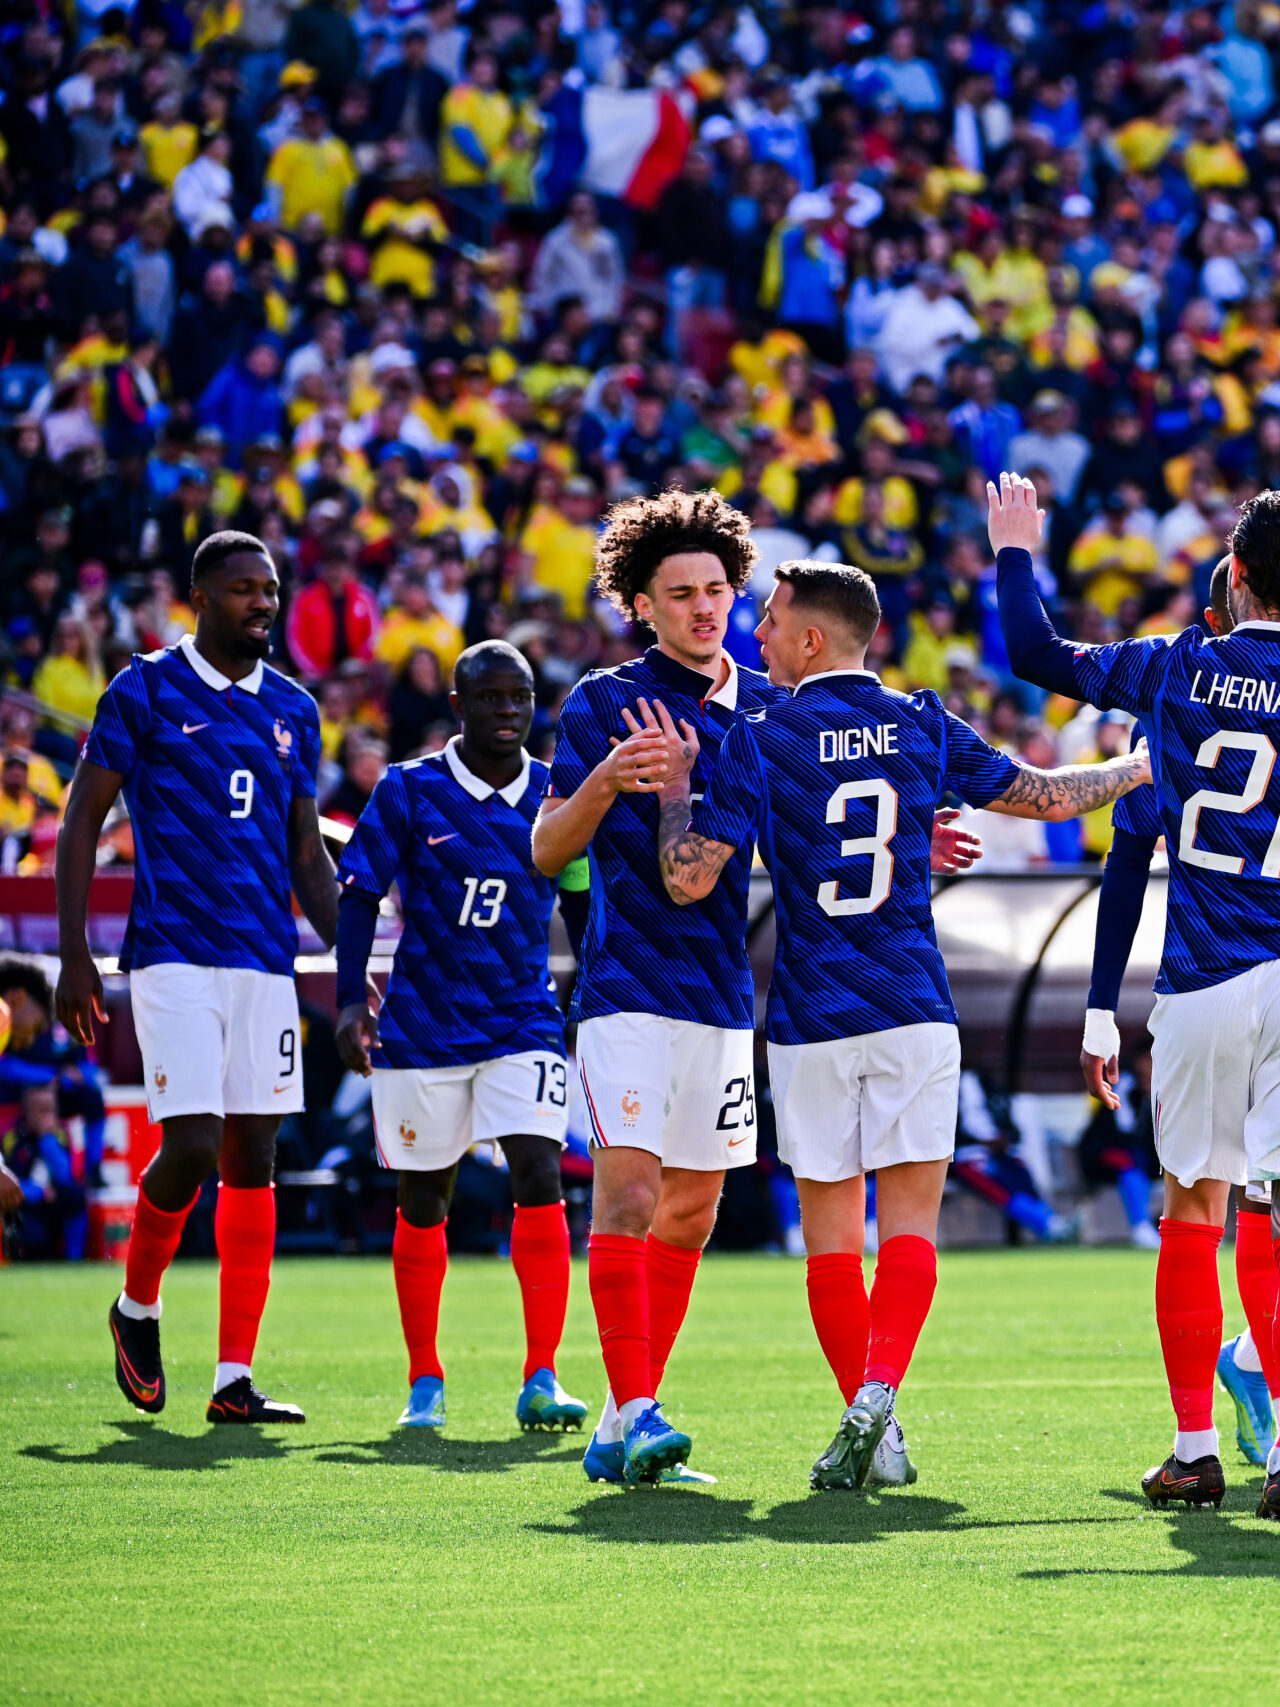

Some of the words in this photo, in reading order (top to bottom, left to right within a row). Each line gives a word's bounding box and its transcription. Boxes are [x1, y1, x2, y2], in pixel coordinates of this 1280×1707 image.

[819, 723, 900, 763] DIGNE
[229, 769, 254, 819] 9
[817, 778, 899, 917] 3
[458, 877, 508, 928] 13
[279, 1028, 295, 1077] 9
[534, 1060, 566, 1107] 13
